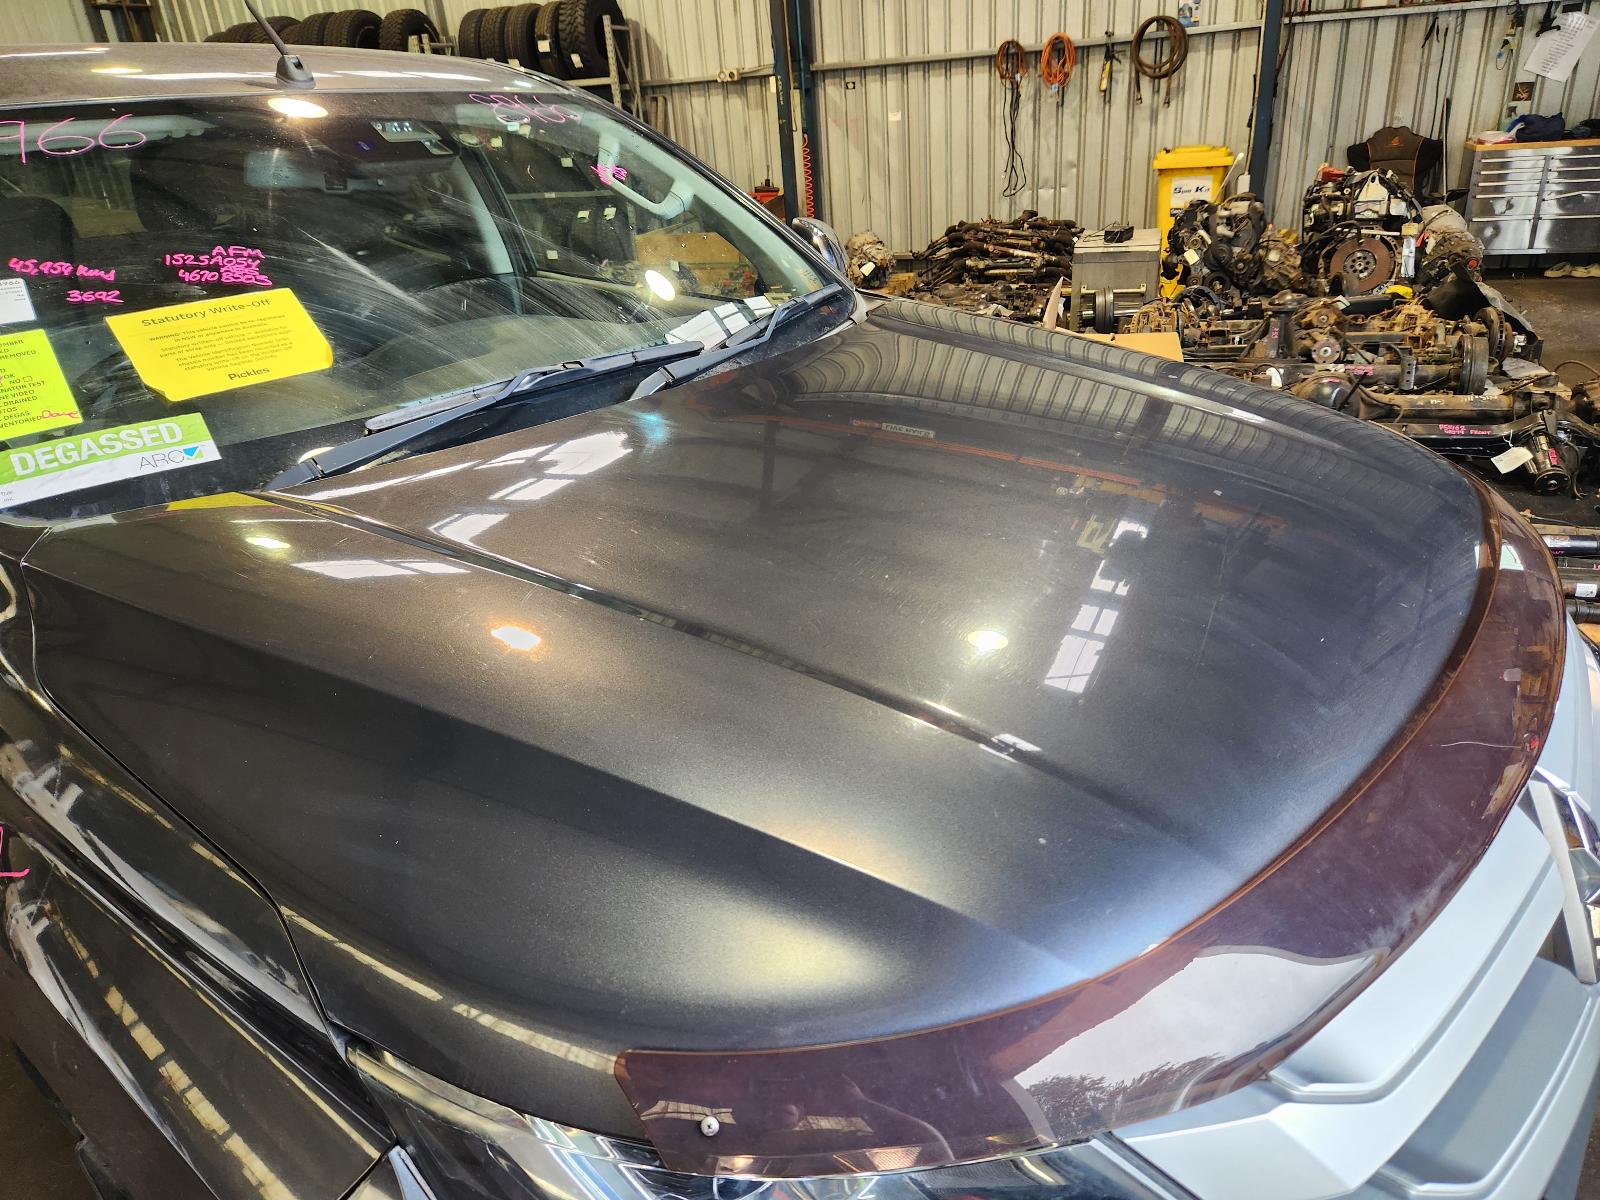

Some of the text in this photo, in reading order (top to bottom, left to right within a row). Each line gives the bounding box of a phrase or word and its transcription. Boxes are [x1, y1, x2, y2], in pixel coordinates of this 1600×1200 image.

[66, 289, 124, 303] 3692
[141, 298, 271, 328] Statutory Write-Off
[227, 366, 271, 381] Pickles
[11, 389, 35, 398] VIDEO
[9, 422, 183, 477] DEGASSED
[139, 448, 185, 471] ARC
